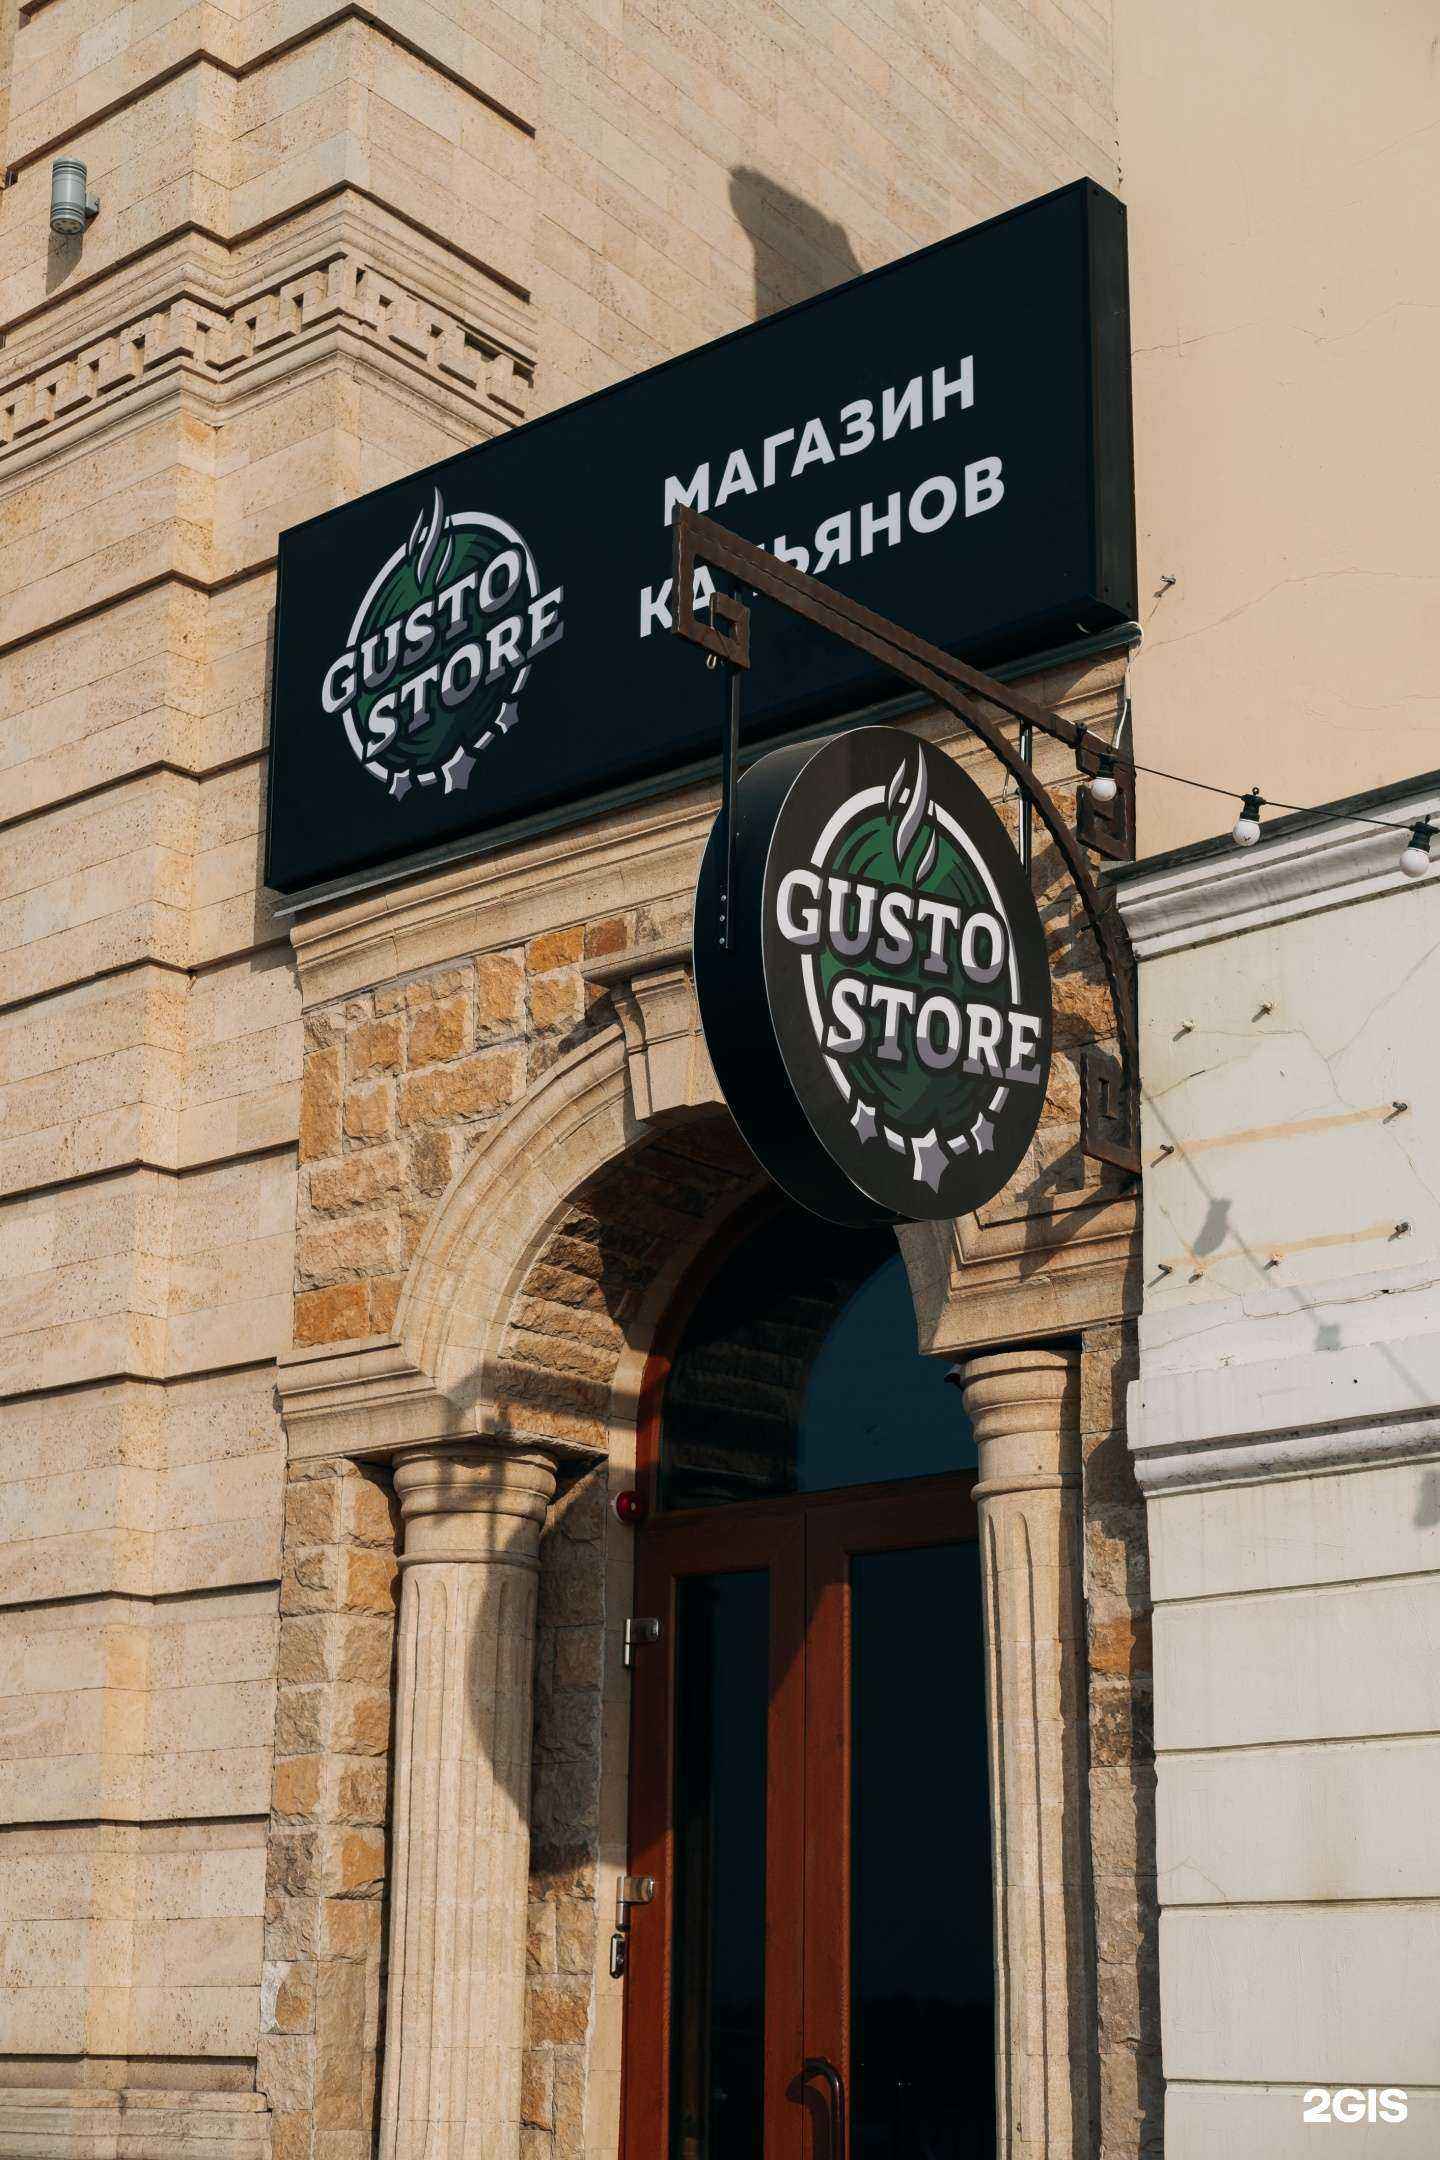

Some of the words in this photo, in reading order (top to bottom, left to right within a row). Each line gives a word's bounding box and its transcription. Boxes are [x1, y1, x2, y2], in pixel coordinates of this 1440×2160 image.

[664, 355, 974, 527] МАГАЗИН
[322, 549, 523, 713] GUSTO
[640, 456, 1005, 638] КАЬЯНОВ
[366, 585, 564, 760] STORE
[776, 869, 1006, 984] GUSTO
[827, 976, 1042, 1085] STORE
